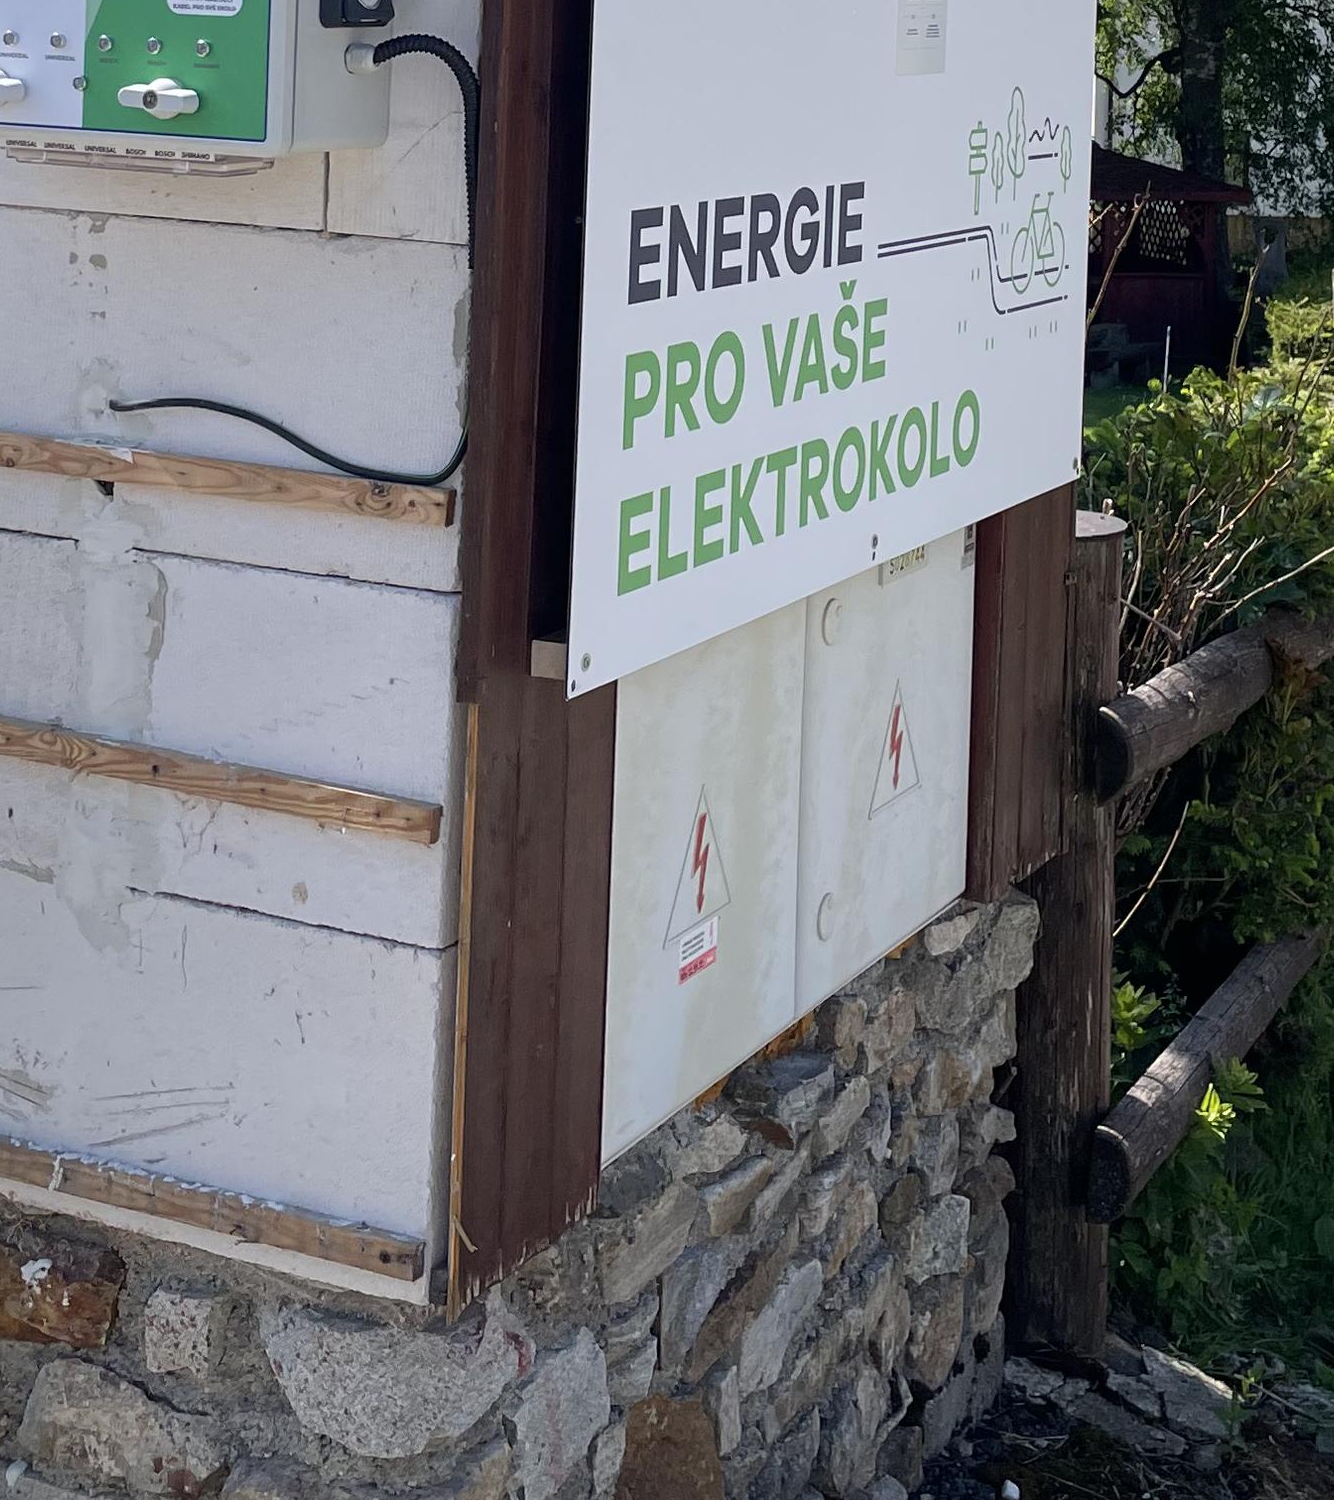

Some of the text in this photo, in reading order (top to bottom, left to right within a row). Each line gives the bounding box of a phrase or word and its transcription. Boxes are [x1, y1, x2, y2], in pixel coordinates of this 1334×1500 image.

[6, 139, 38, 148] UNIVERSAL
[44, 142, 76, 151] UNIVERSAL
[84, 145, 117, 154] UNIVERSAL
[125, 148, 147, 156] BOSCH
[154, 150, 176, 158] BOSCH
[627, 180, 866, 305] ENERGIE
[622, 278, 889, 451] PRO VAŠE
[616, 388, 981, 597] ELEKTROKOLO
